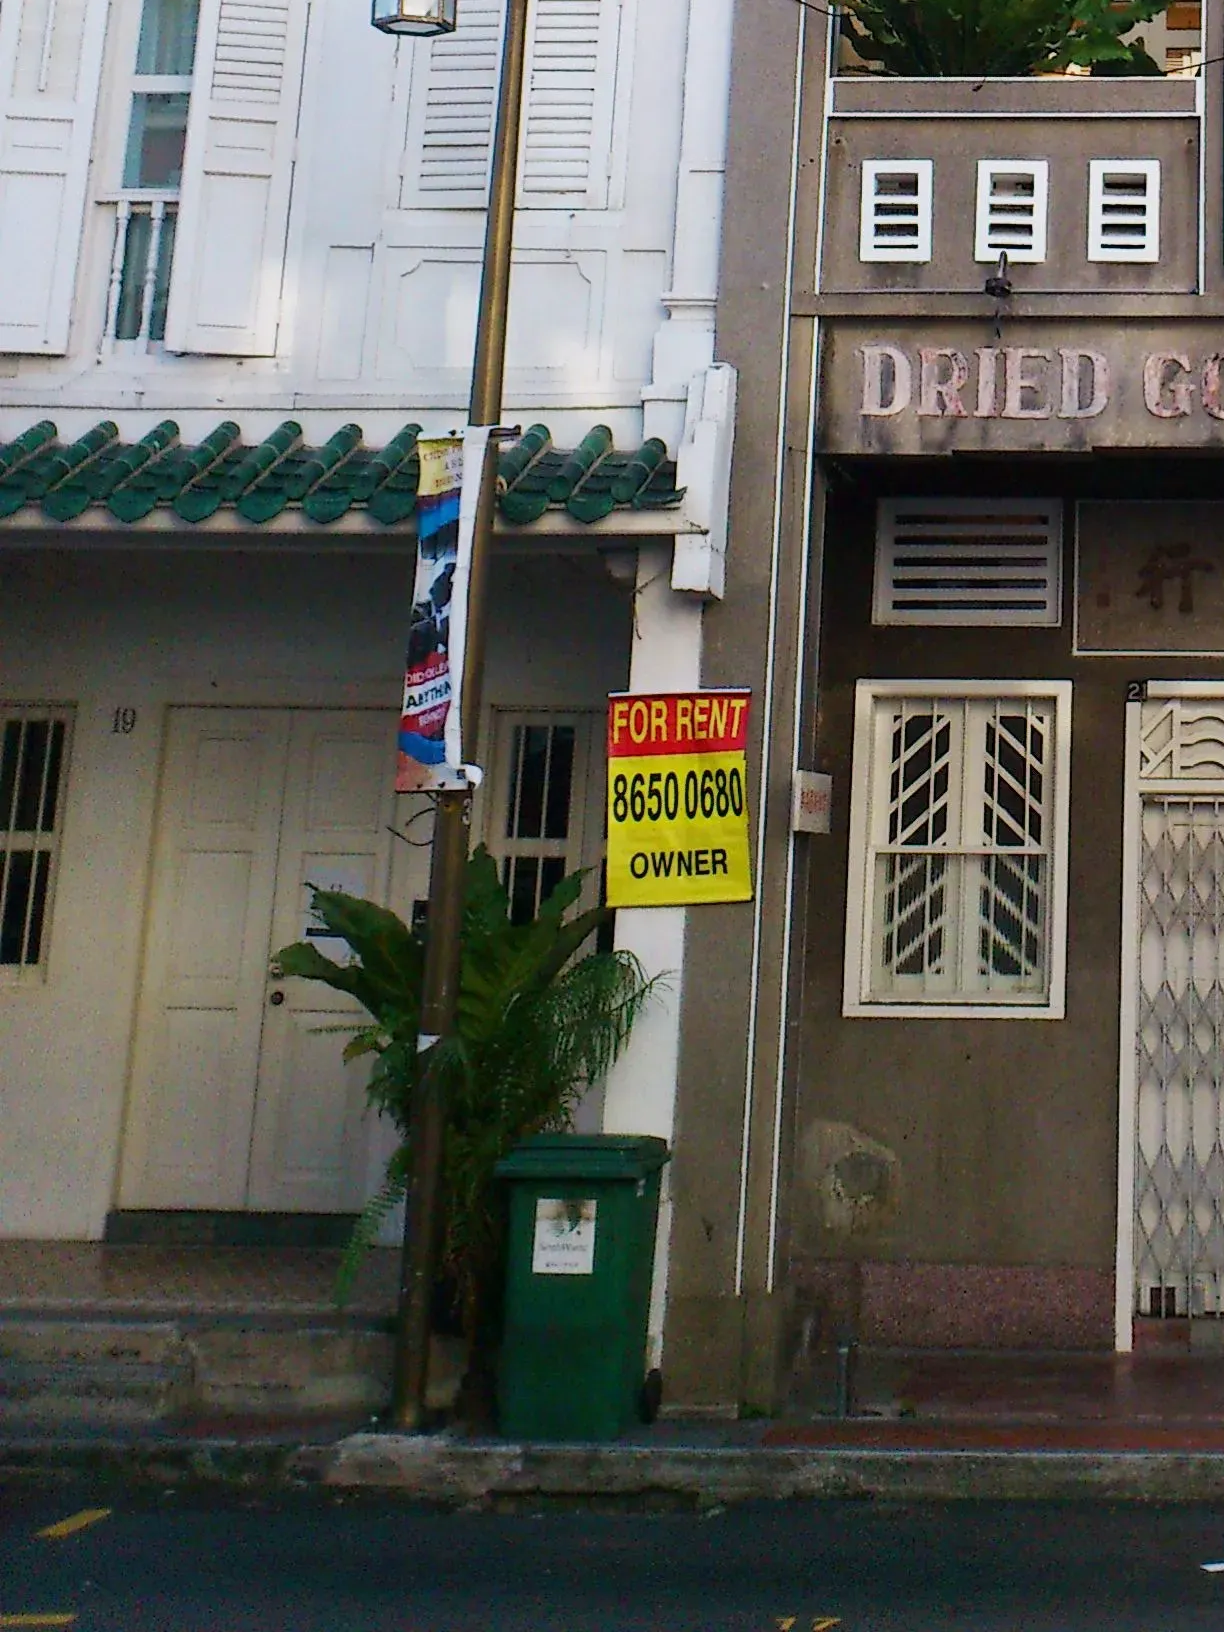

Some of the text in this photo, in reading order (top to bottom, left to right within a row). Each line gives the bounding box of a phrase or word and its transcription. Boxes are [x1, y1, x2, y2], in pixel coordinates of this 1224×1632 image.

[856, 343, 1109, 421] DRIED
[1127, 683, 1147, 700] 21
[111, 707, 136, 734] 19
[612, 699, 747, 744] FOR RENT
[613, 767, 743, 822] 8650 0680
[630, 849, 729, 880] OWNER
